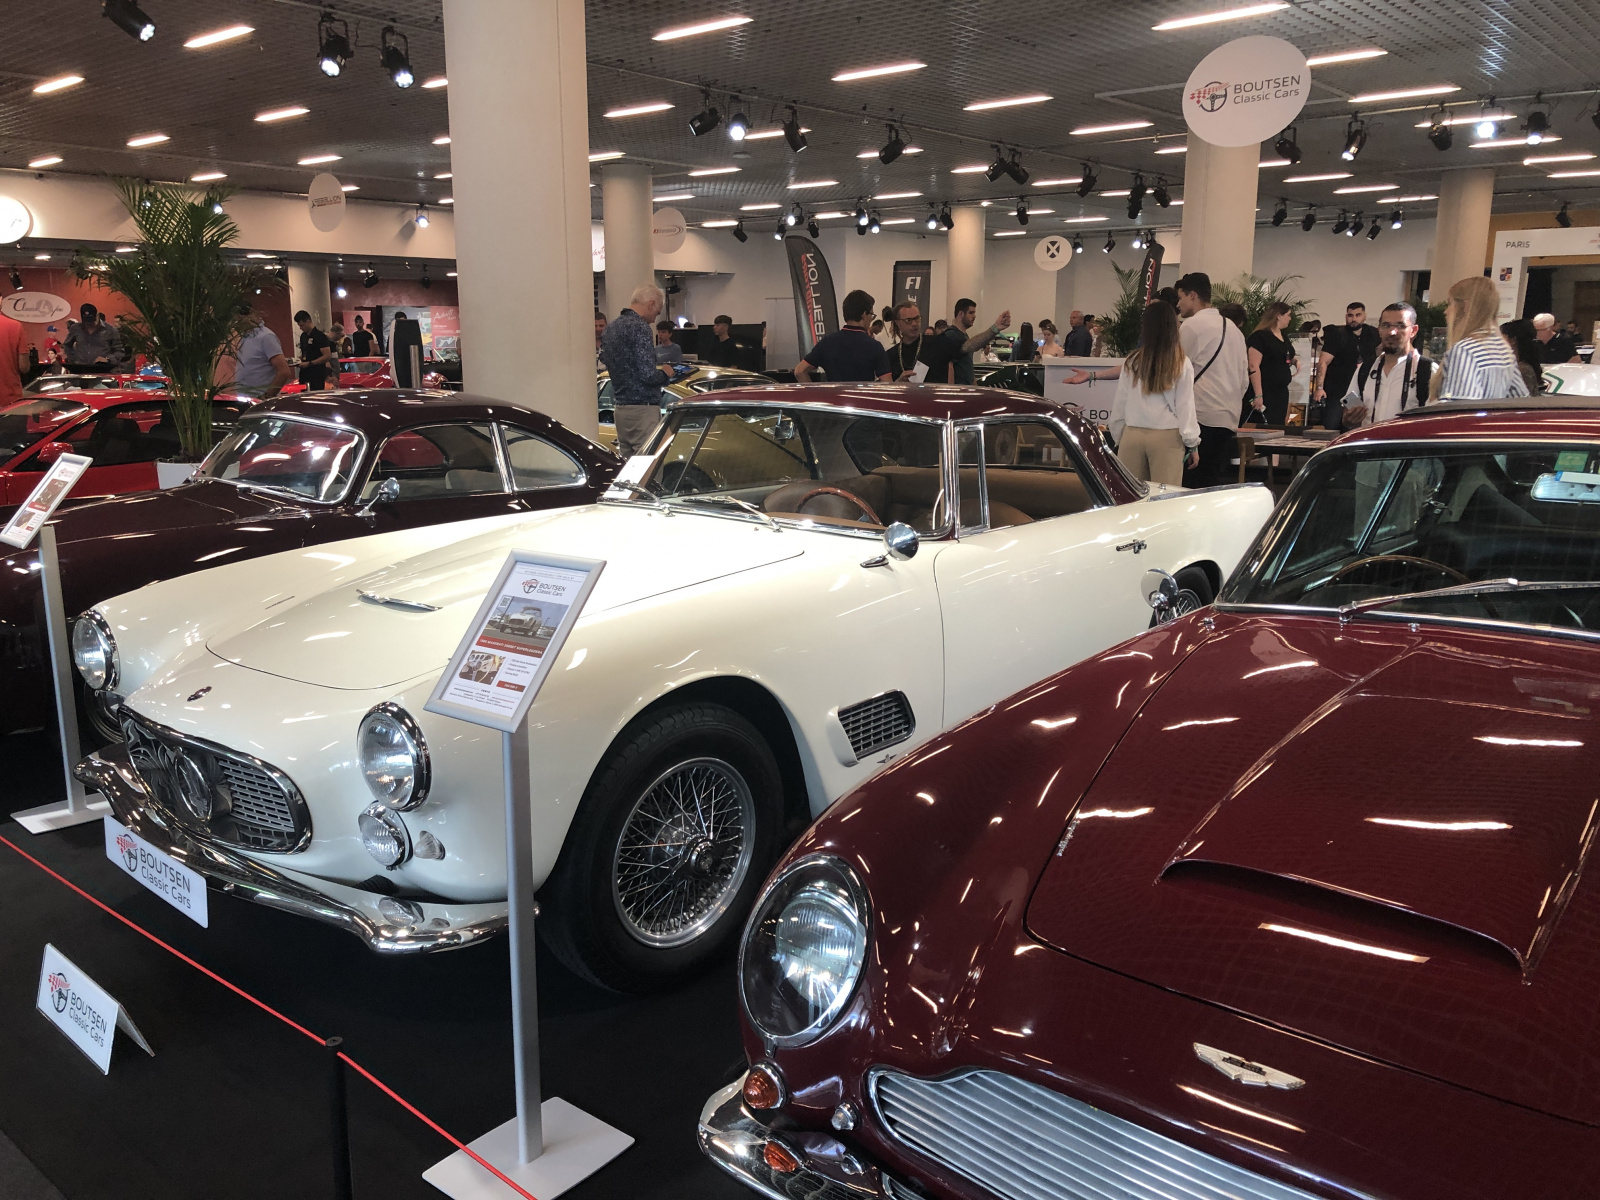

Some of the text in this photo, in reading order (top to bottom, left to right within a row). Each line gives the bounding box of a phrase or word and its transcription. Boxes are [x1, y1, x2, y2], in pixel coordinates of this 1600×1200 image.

[1233, 87, 1300, 105] Classic Cars
[1234, 75, 1301, 94] BOUTSEN
[1505, 241, 1531, 249] PARIS
[539, 583, 567, 592] BOUTSEN
[140, 848, 191, 893] BOUTSEN
[141, 866, 191, 909] Classic Cars
[69, 1007, 105, 1047] Classic Cars
[70, 992, 108, 1034] BOUTSEN
